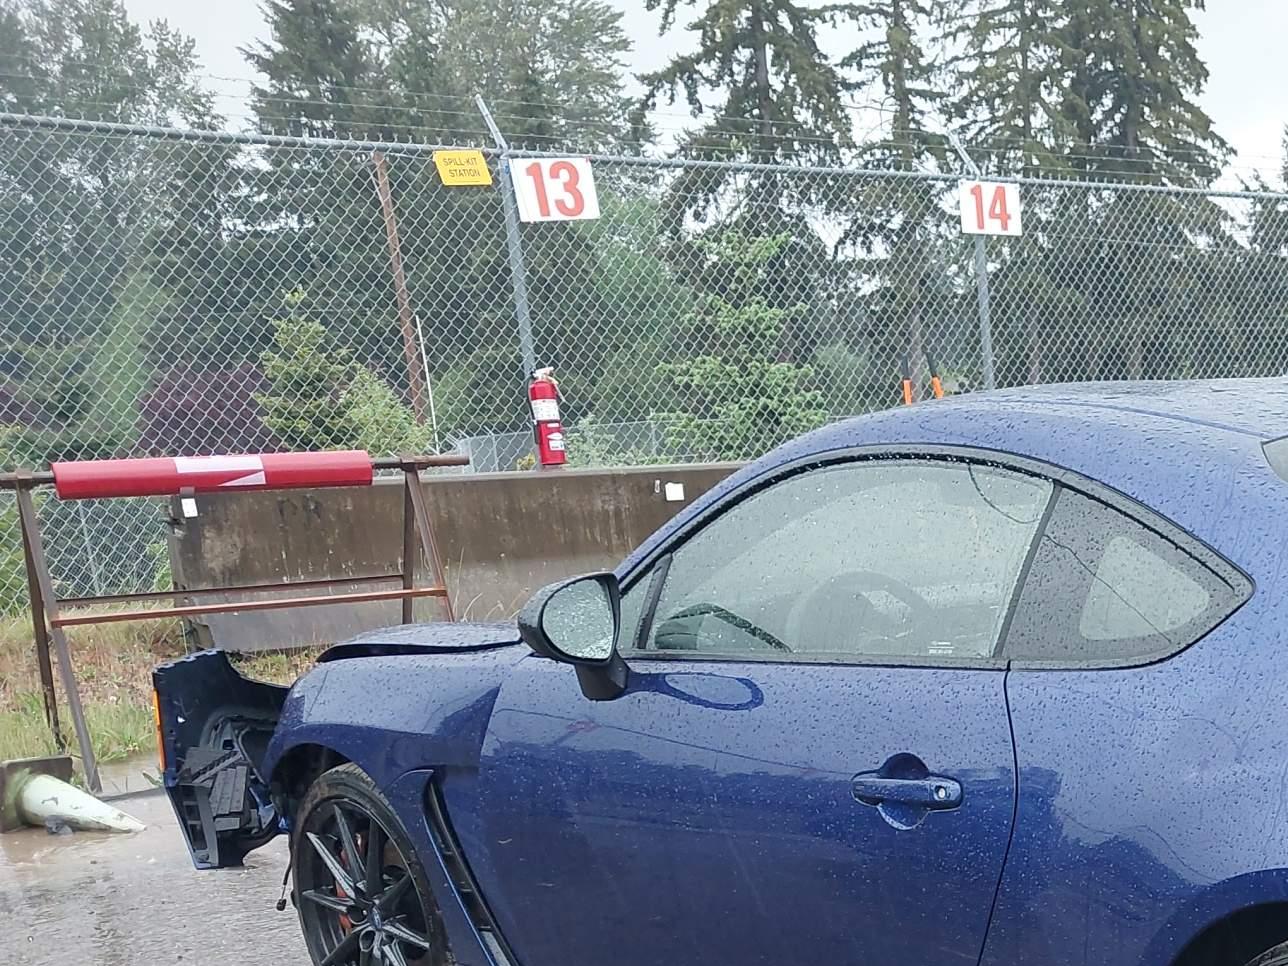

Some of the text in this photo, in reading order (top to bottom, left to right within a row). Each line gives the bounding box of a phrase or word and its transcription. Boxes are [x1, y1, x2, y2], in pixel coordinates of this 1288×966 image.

[448, 168, 481, 178] STATION
[526, 160, 585, 217] 13
[970, 184, 1012, 231] 14
